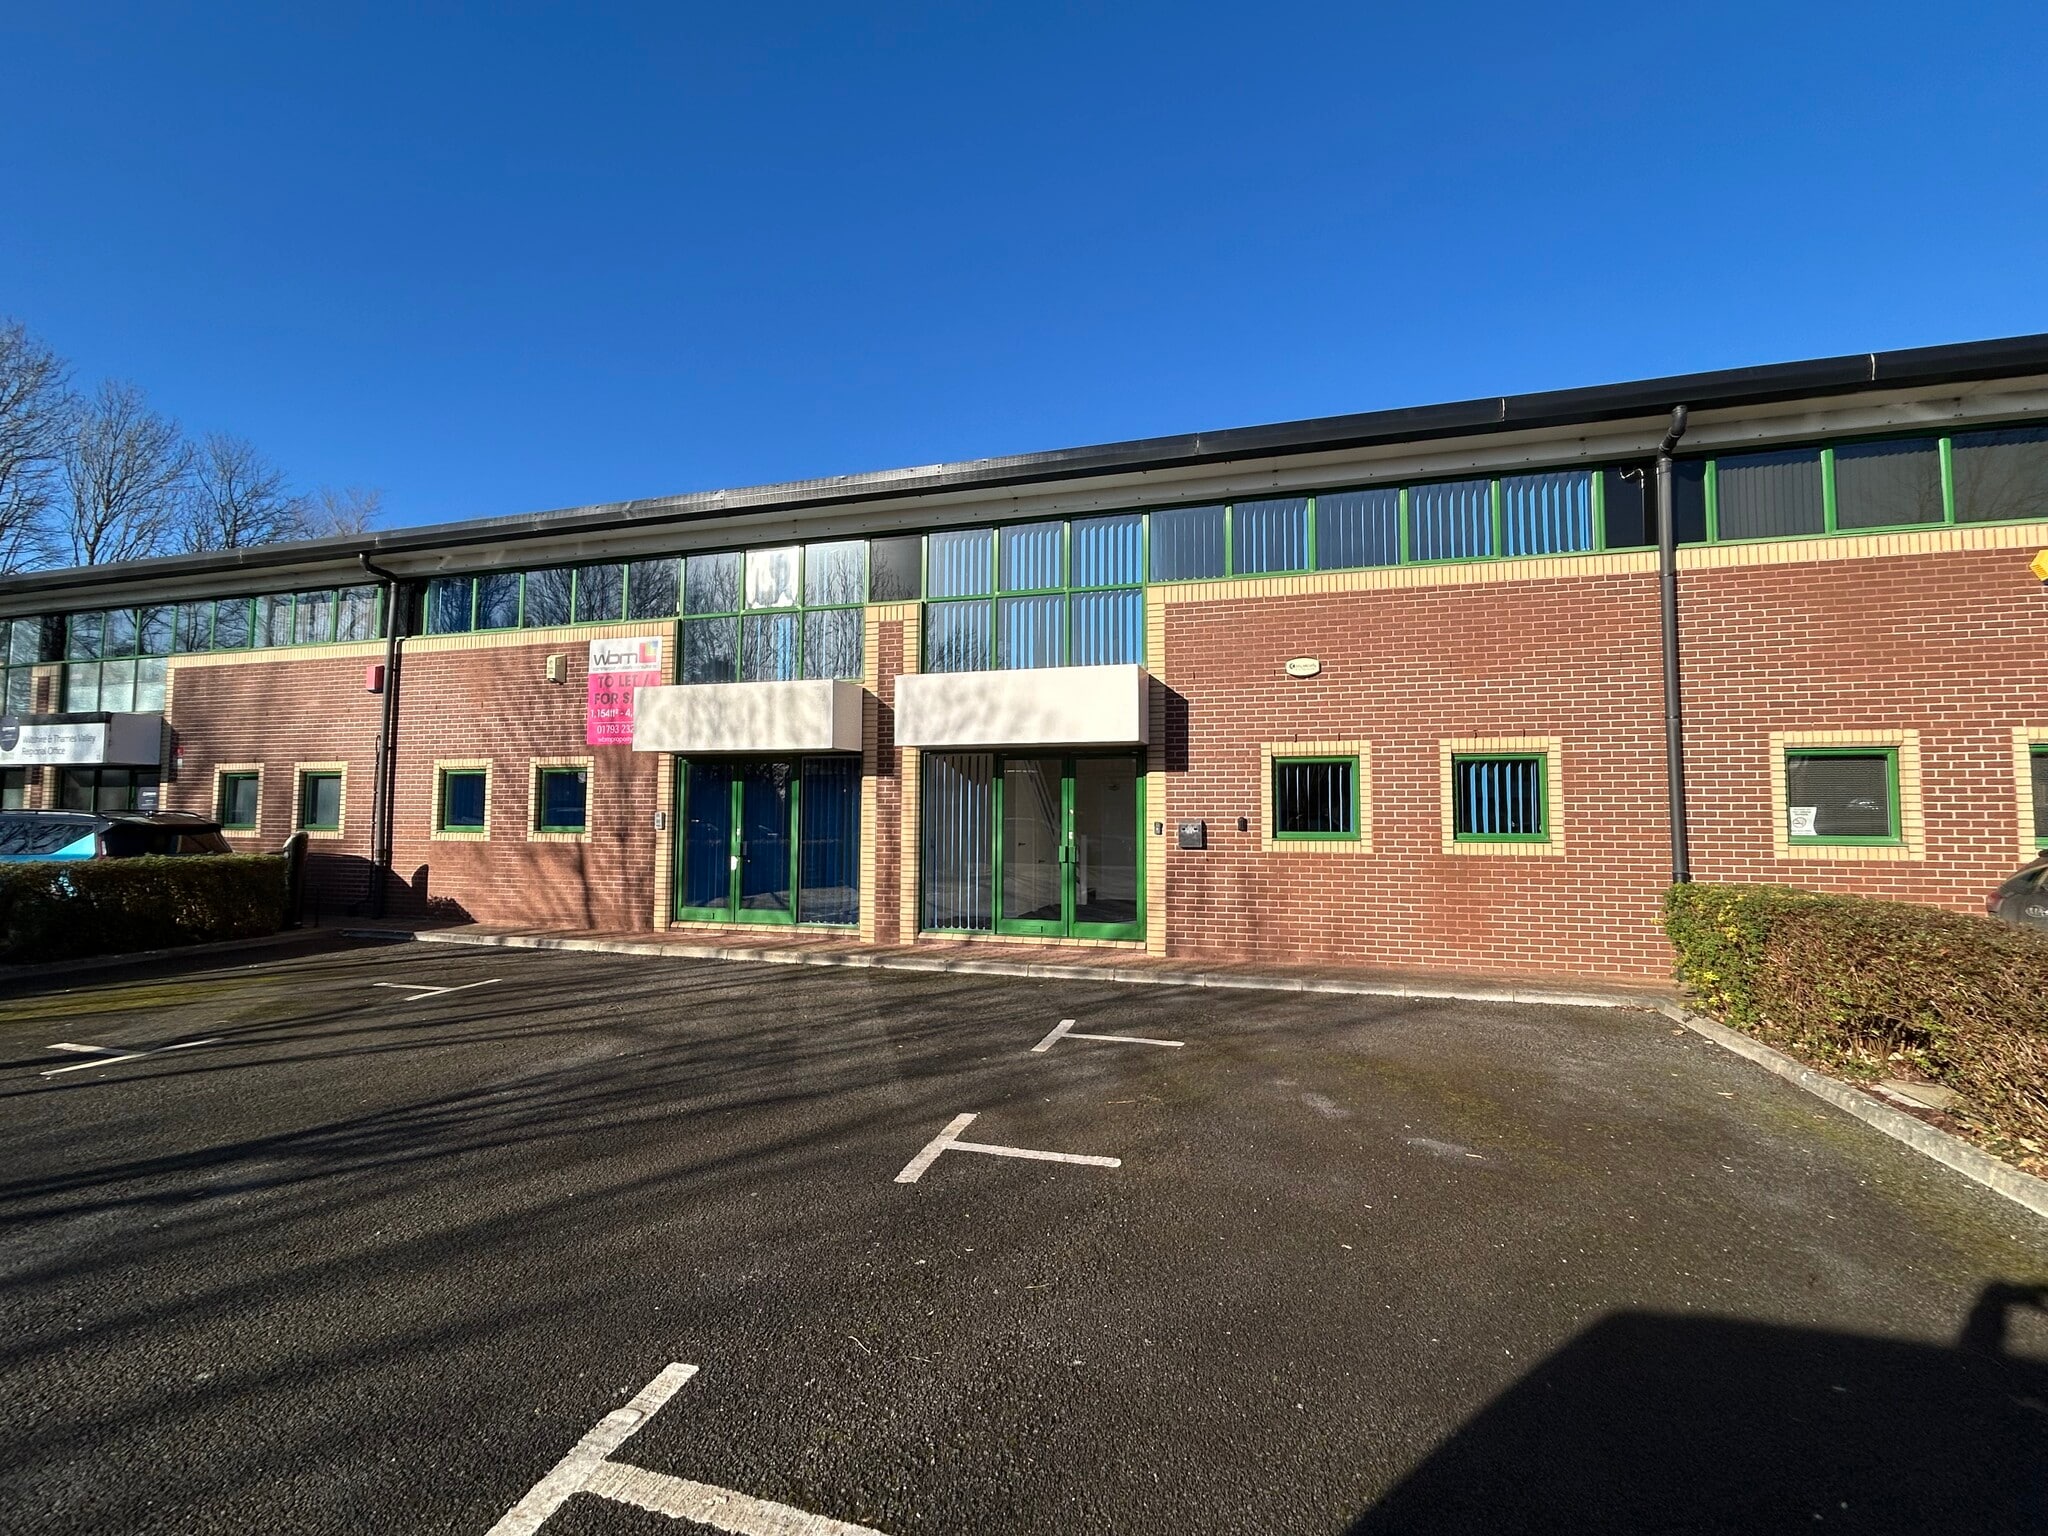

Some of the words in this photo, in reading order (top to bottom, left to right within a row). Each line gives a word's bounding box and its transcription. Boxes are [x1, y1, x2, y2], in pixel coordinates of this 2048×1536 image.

[598, 675, 614, 688] TO
[619, 674, 638, 687] LET
[594, 692, 618, 705] FOR
[622, 692, 634, 704] S
[597, 724, 619, 734] 01793
[77, 733, 97, 745] Valley
[47, 746, 66, 756] Office
